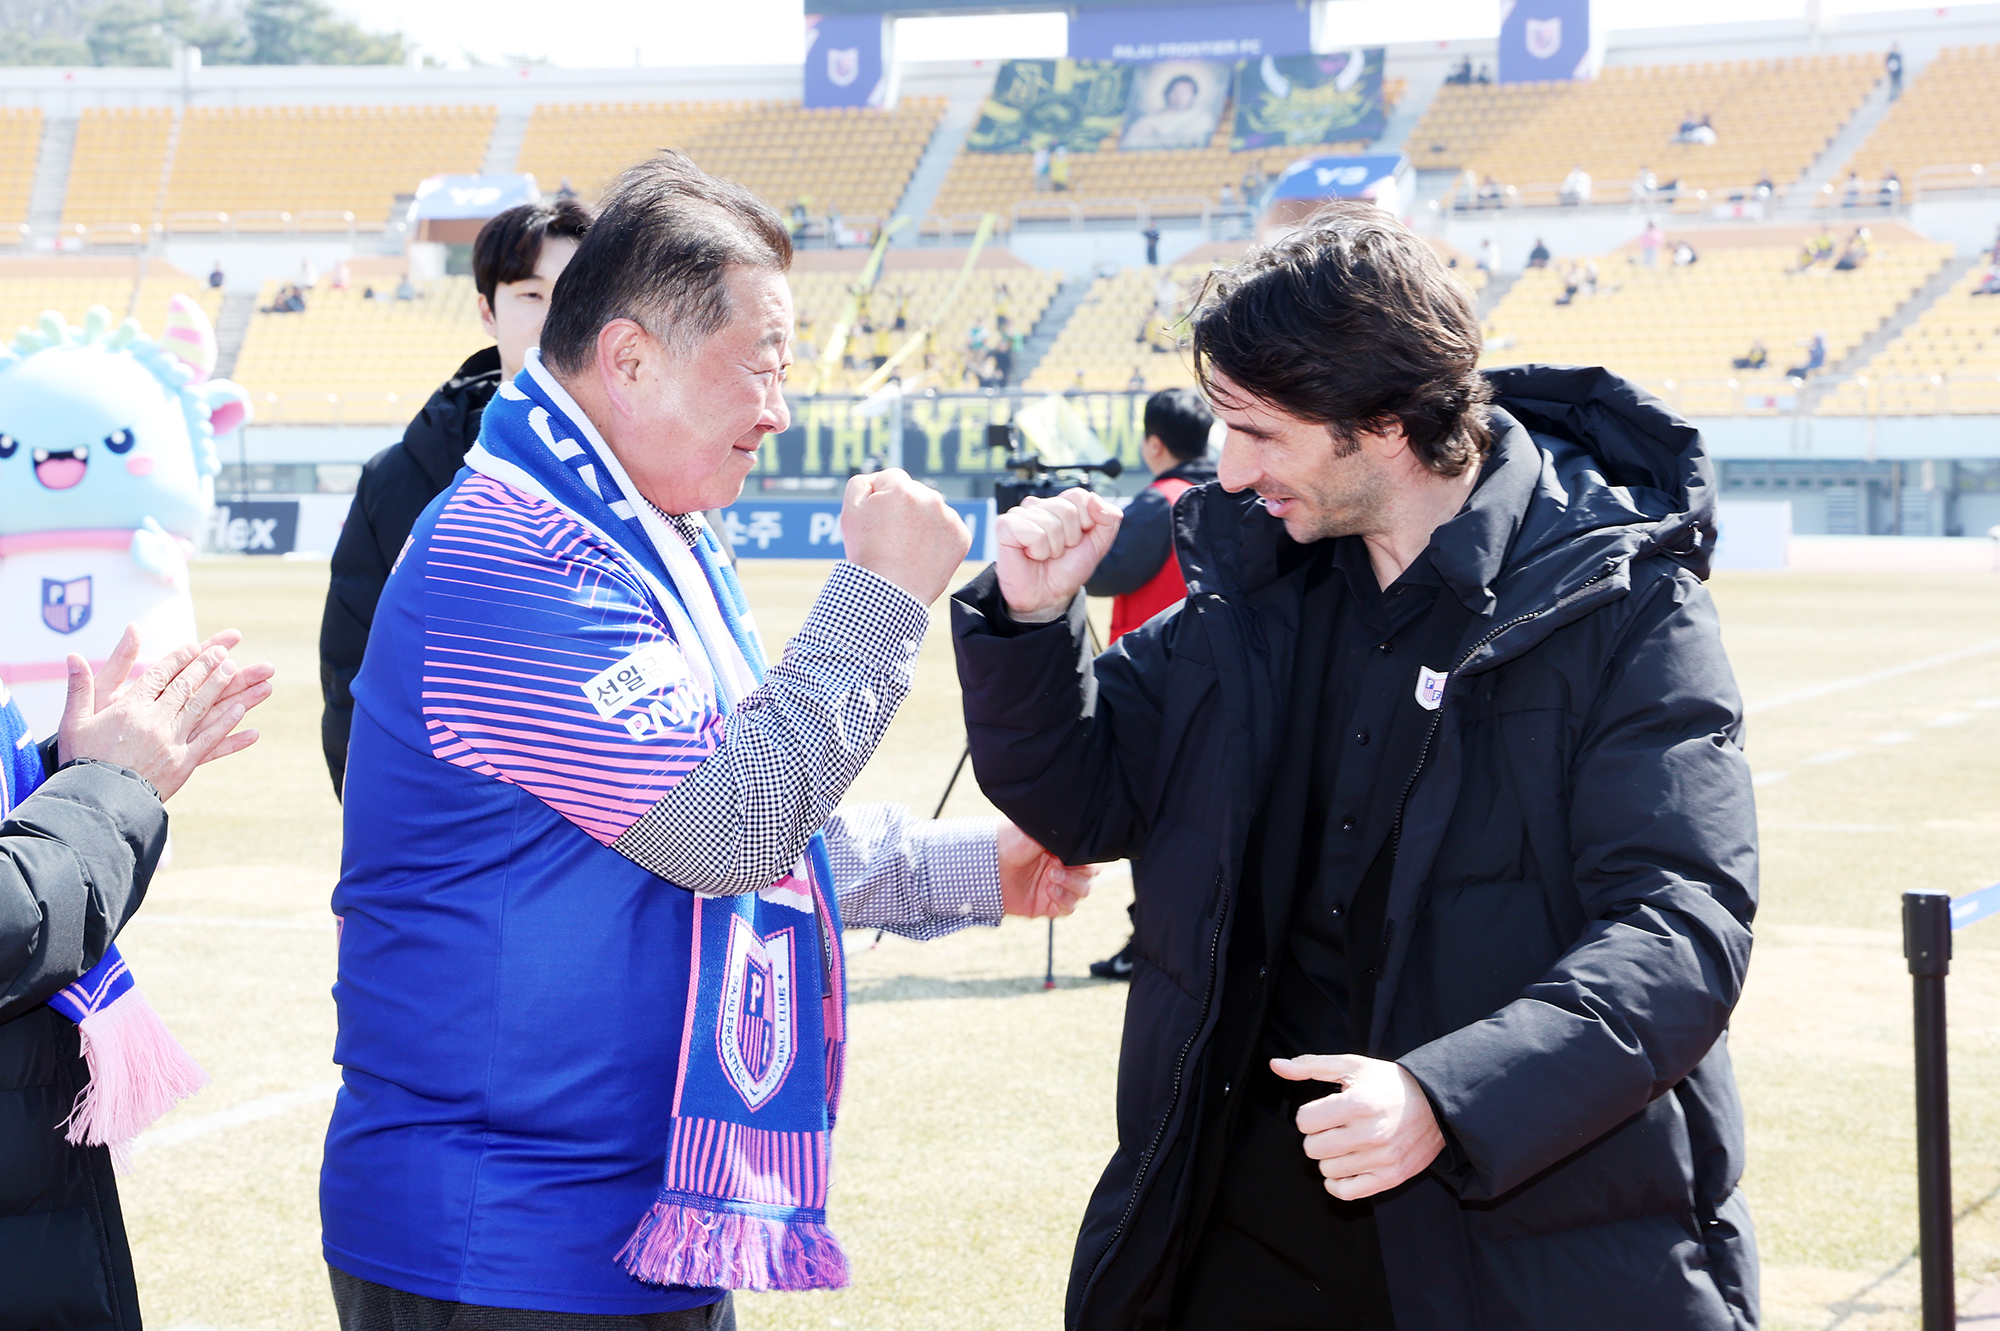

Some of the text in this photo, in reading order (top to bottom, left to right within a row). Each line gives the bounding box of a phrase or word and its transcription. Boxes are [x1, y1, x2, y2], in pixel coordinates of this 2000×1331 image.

[1112, 38, 1262, 60] PAJU FRONTIER FC
[727, 975, 739, 1013] PAJU
[778, 987, 787, 1023] CLUB
